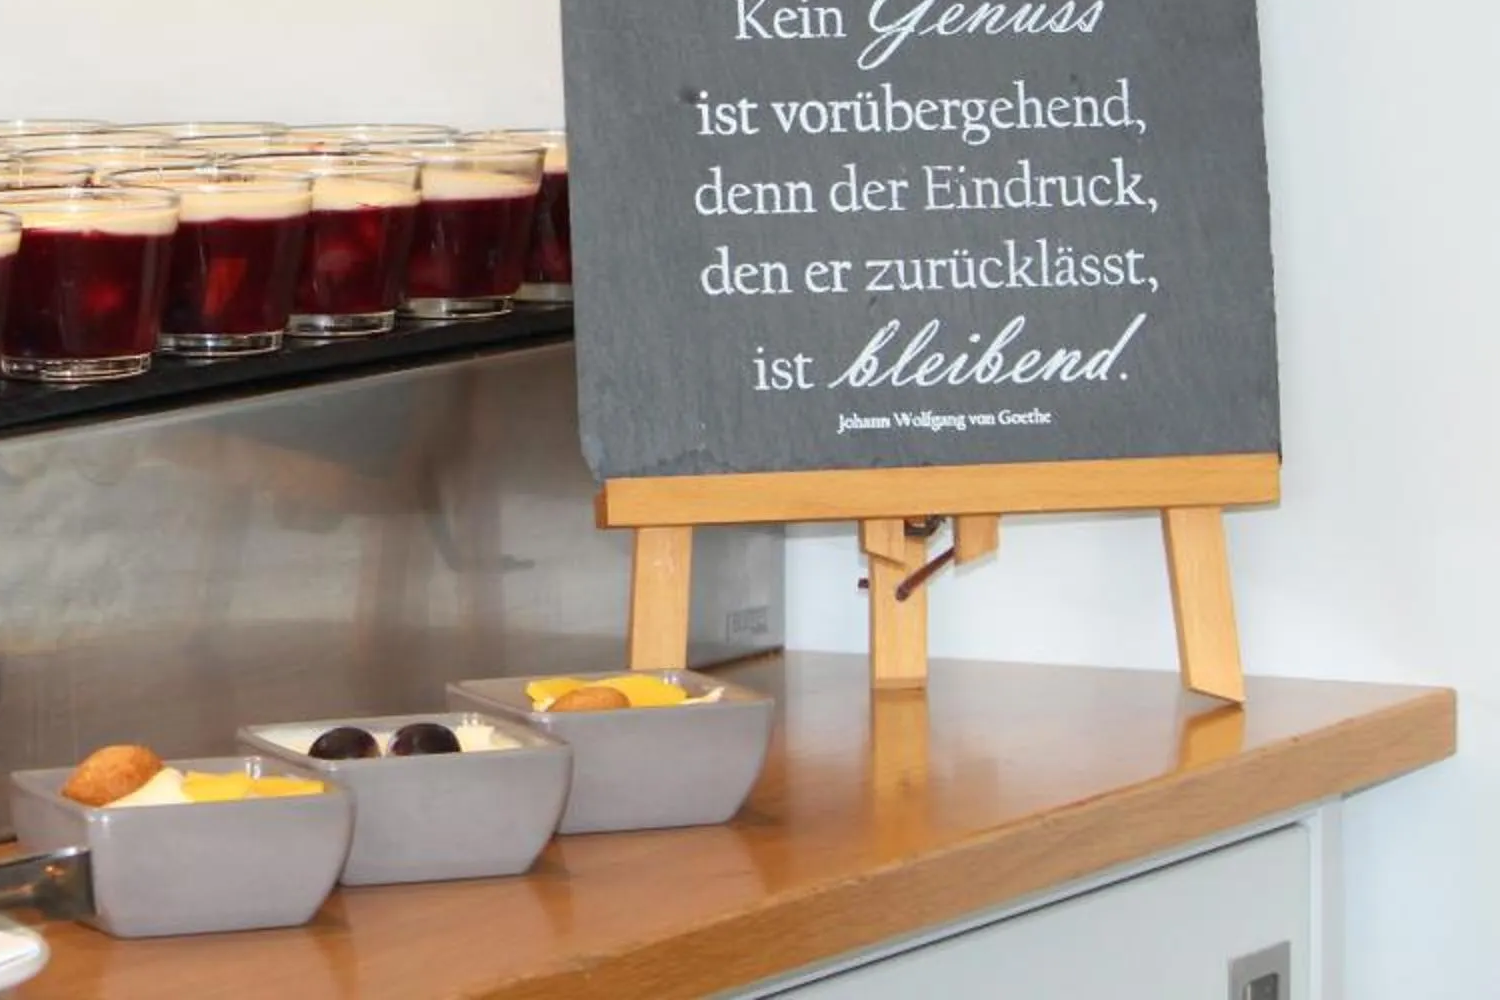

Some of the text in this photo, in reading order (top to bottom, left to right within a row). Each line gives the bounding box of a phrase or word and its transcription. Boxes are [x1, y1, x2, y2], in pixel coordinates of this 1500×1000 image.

[695, 77, 1147, 147] ist vorübergehend,
[694, 156, 1158, 216] denn der Eindruck,
[700, 237, 1159, 296] den er zurücklässt,
[752, 312, 1147, 391] ist bleibend.
[836, 407, 1052, 434] Johann Wolfgang von Goethe
